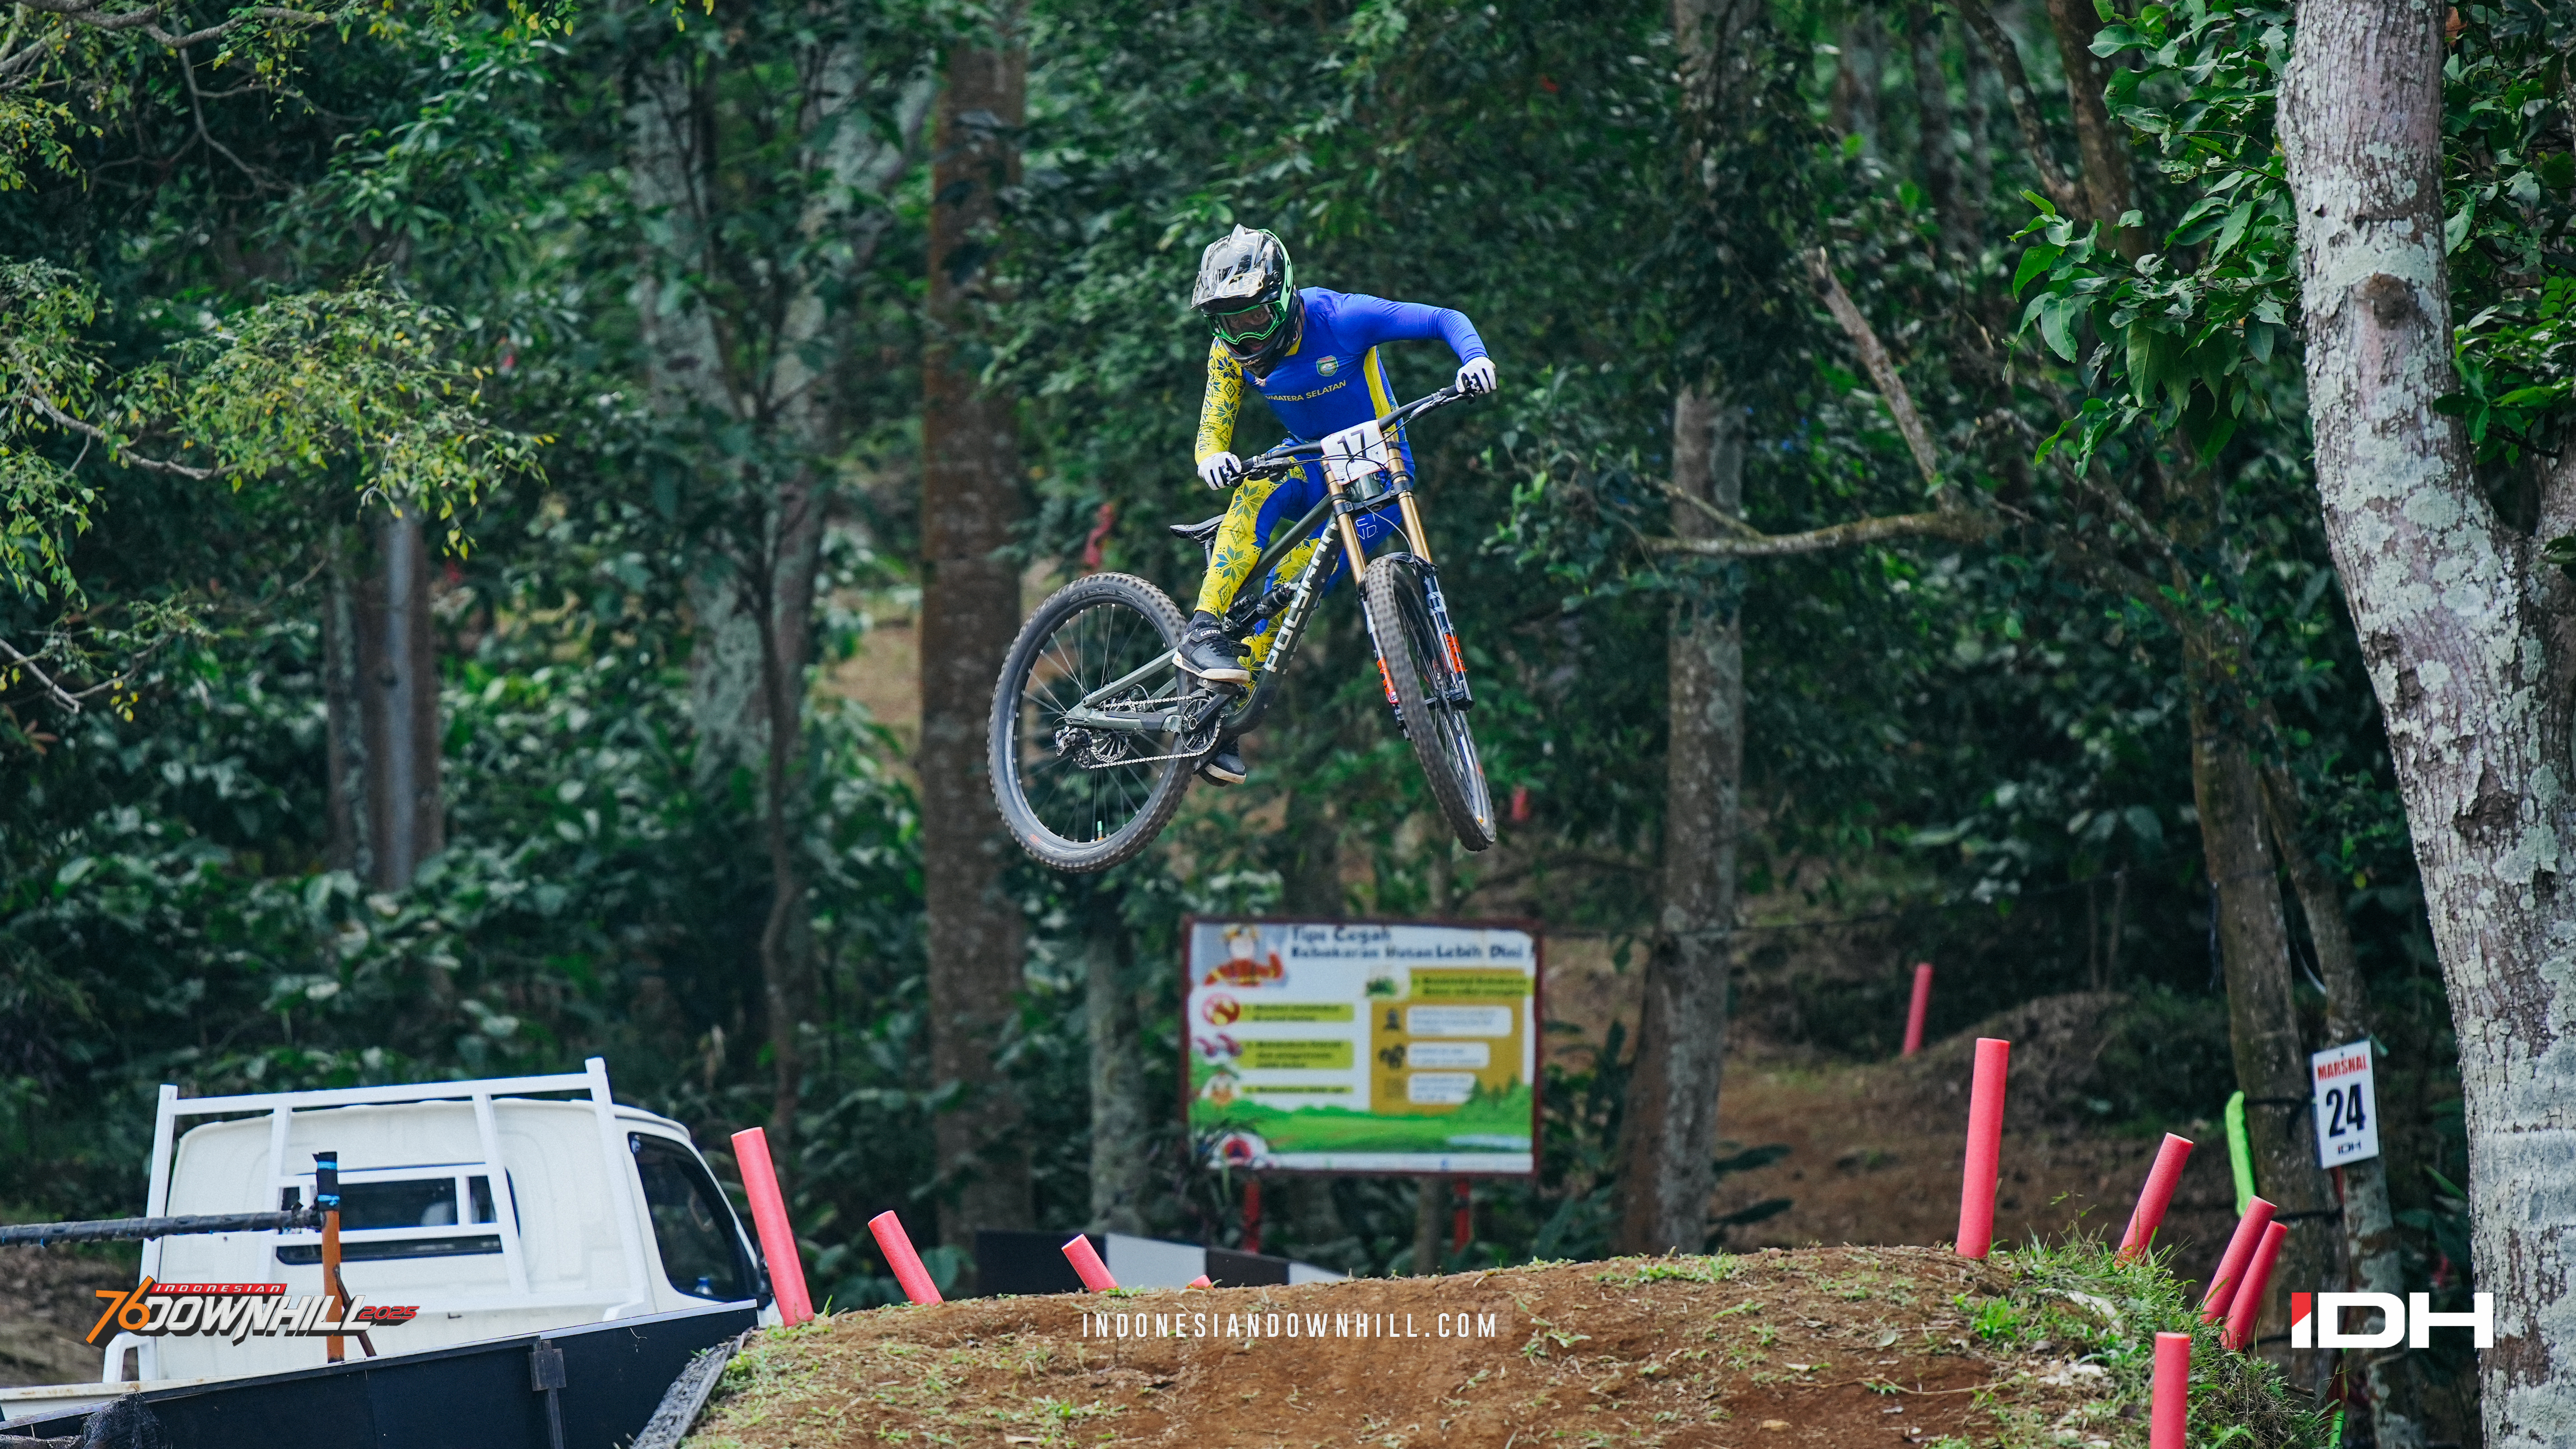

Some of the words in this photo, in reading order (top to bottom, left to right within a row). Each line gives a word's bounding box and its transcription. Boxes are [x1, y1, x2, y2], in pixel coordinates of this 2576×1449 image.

[1306, 380, 1346, 399] SELATAN
[1337, 429, 1366, 463] 17
[2318, 1054, 2368, 1081] MARSHAL
[2327, 1082, 2367, 1138] 24
